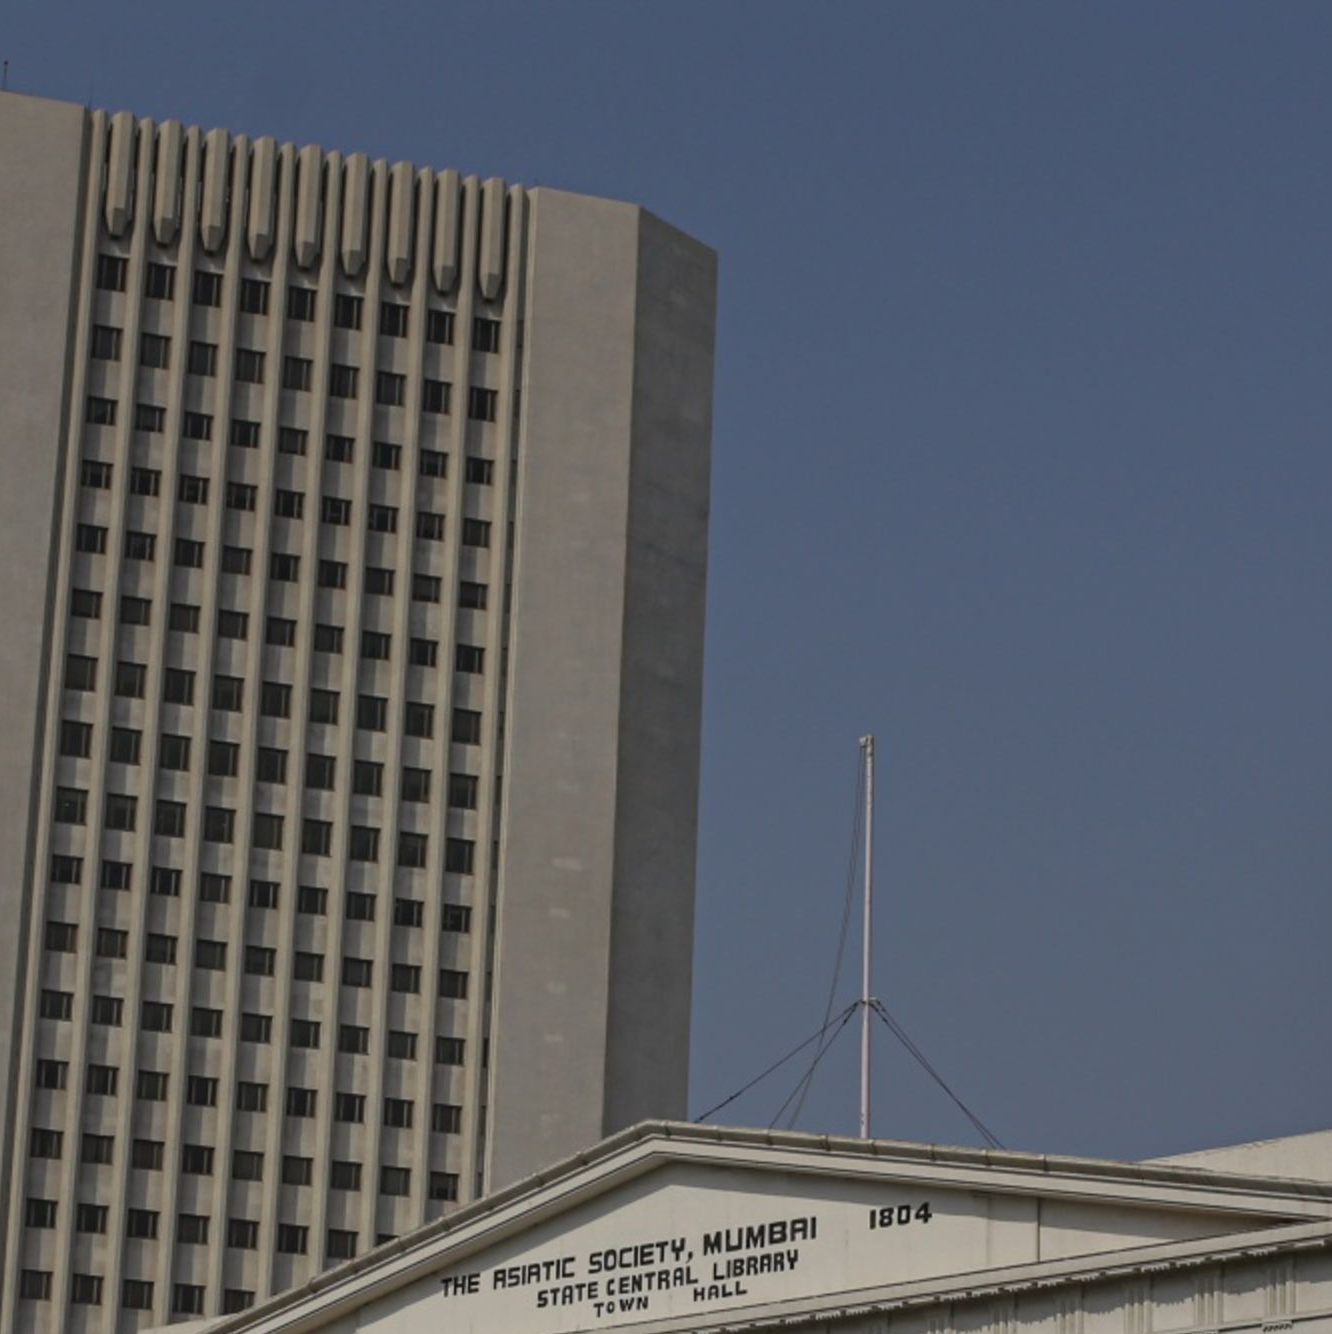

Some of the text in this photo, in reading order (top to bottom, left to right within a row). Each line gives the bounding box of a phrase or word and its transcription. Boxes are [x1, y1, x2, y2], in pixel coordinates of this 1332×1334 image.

[870, 1202, 932, 1230] 1804
[441, 1216, 817, 1297] THE ASIATIC SOCIETY, MUMBAI
[537, 1249, 799, 1308] STATE CENTRAL LIBRARY
[593, 1281, 748, 1318] TOWN HALL
